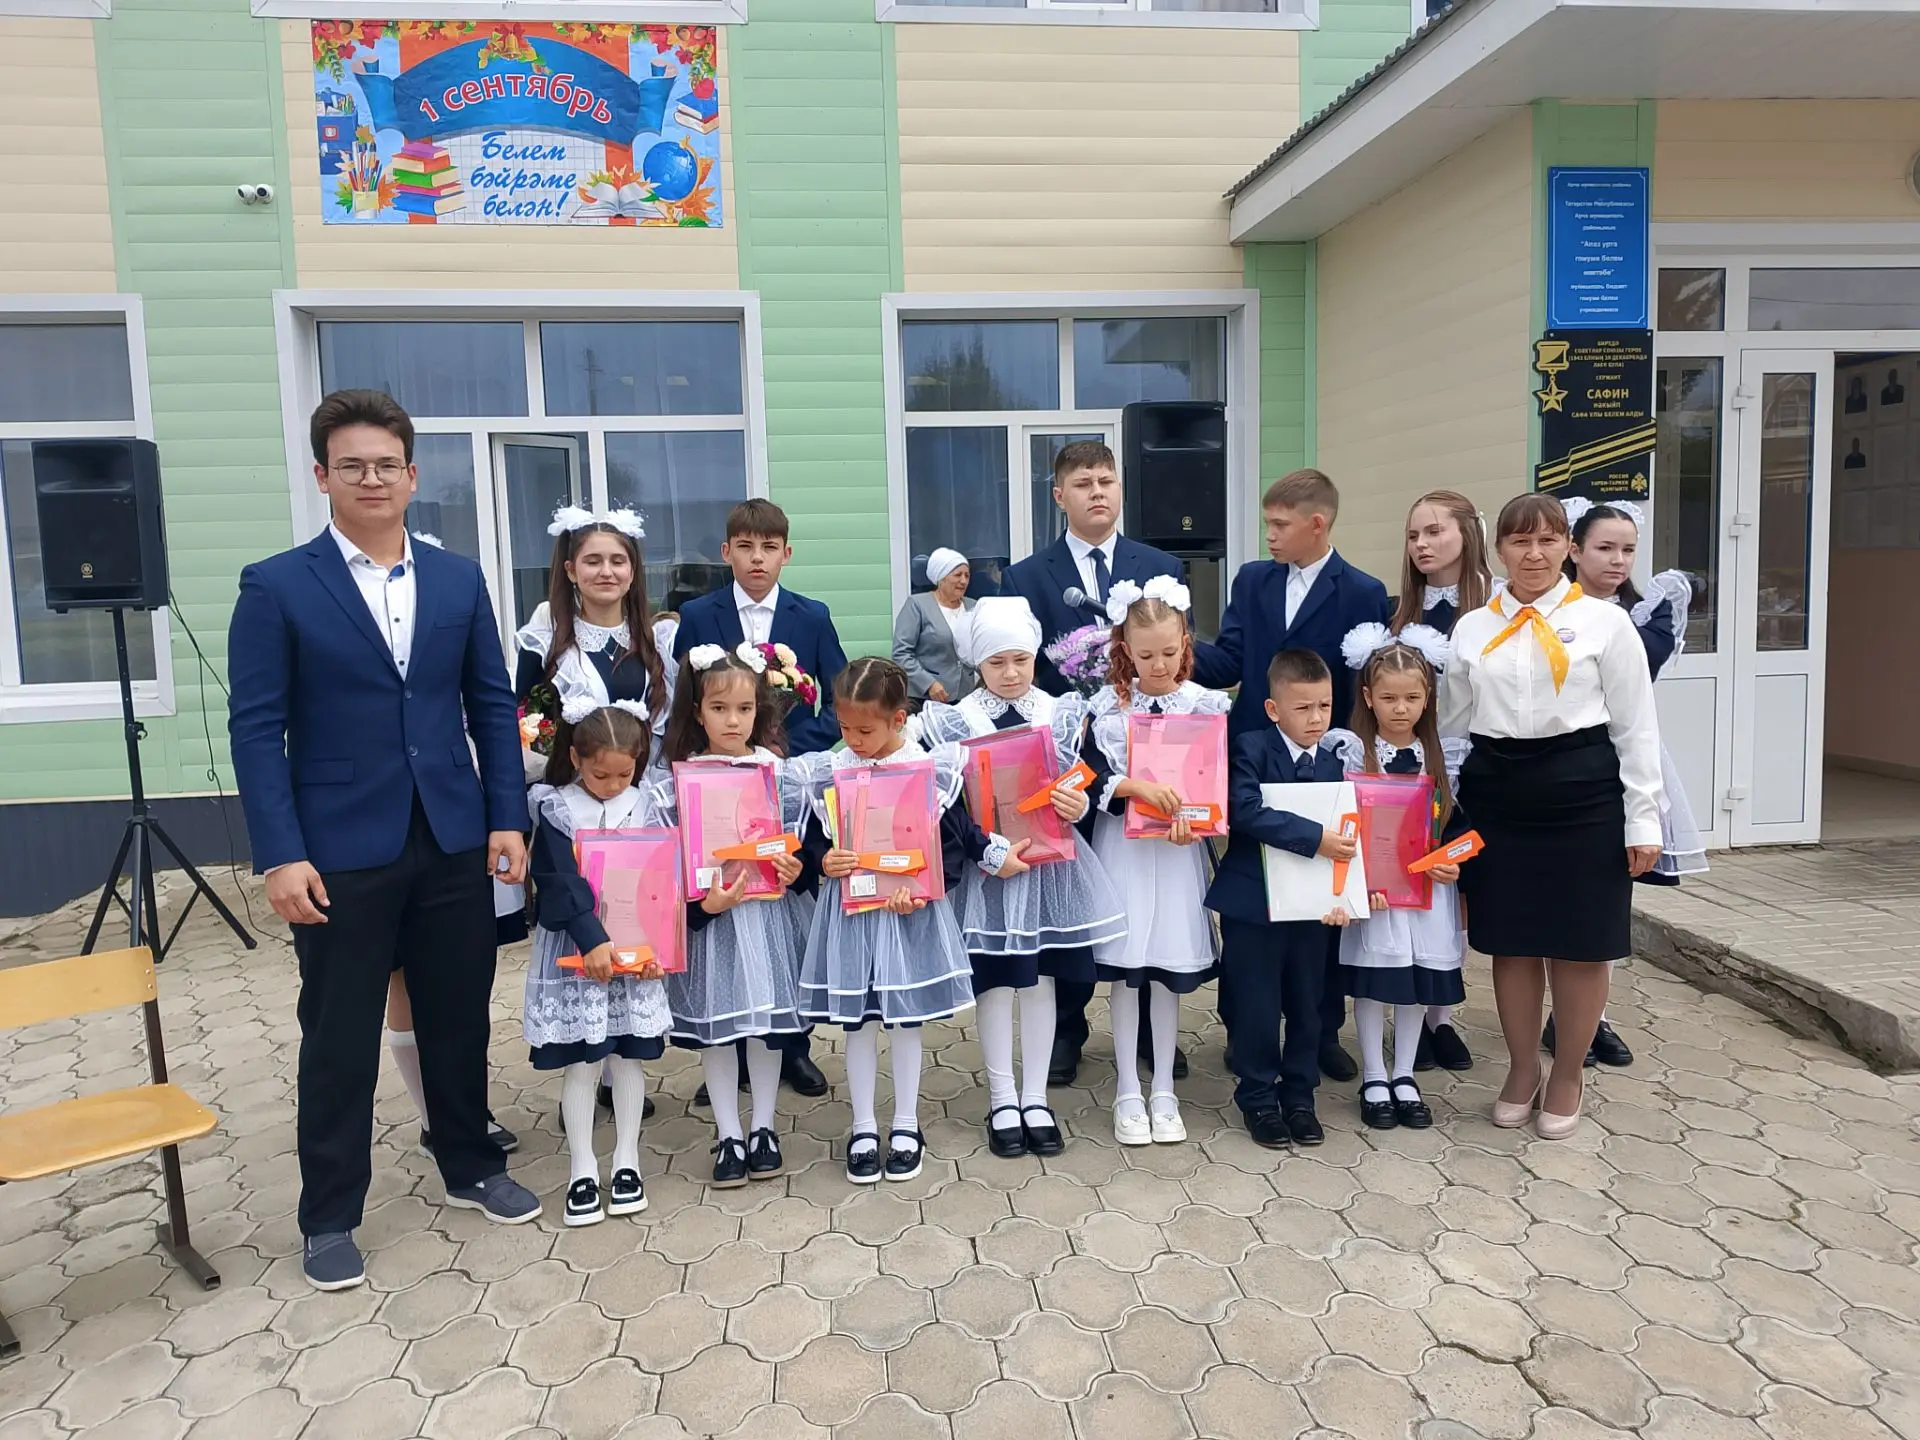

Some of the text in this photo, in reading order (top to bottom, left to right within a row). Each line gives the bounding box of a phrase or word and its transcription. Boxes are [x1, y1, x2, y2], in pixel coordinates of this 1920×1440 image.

[419, 73, 612, 124] 1 сентябрь
[482, 131, 567, 161] Белем
[470, 165, 577, 196] бәйрәме
[483, 191, 568, 218] белән!
[1586, 388, 1629, 400] САФИН
